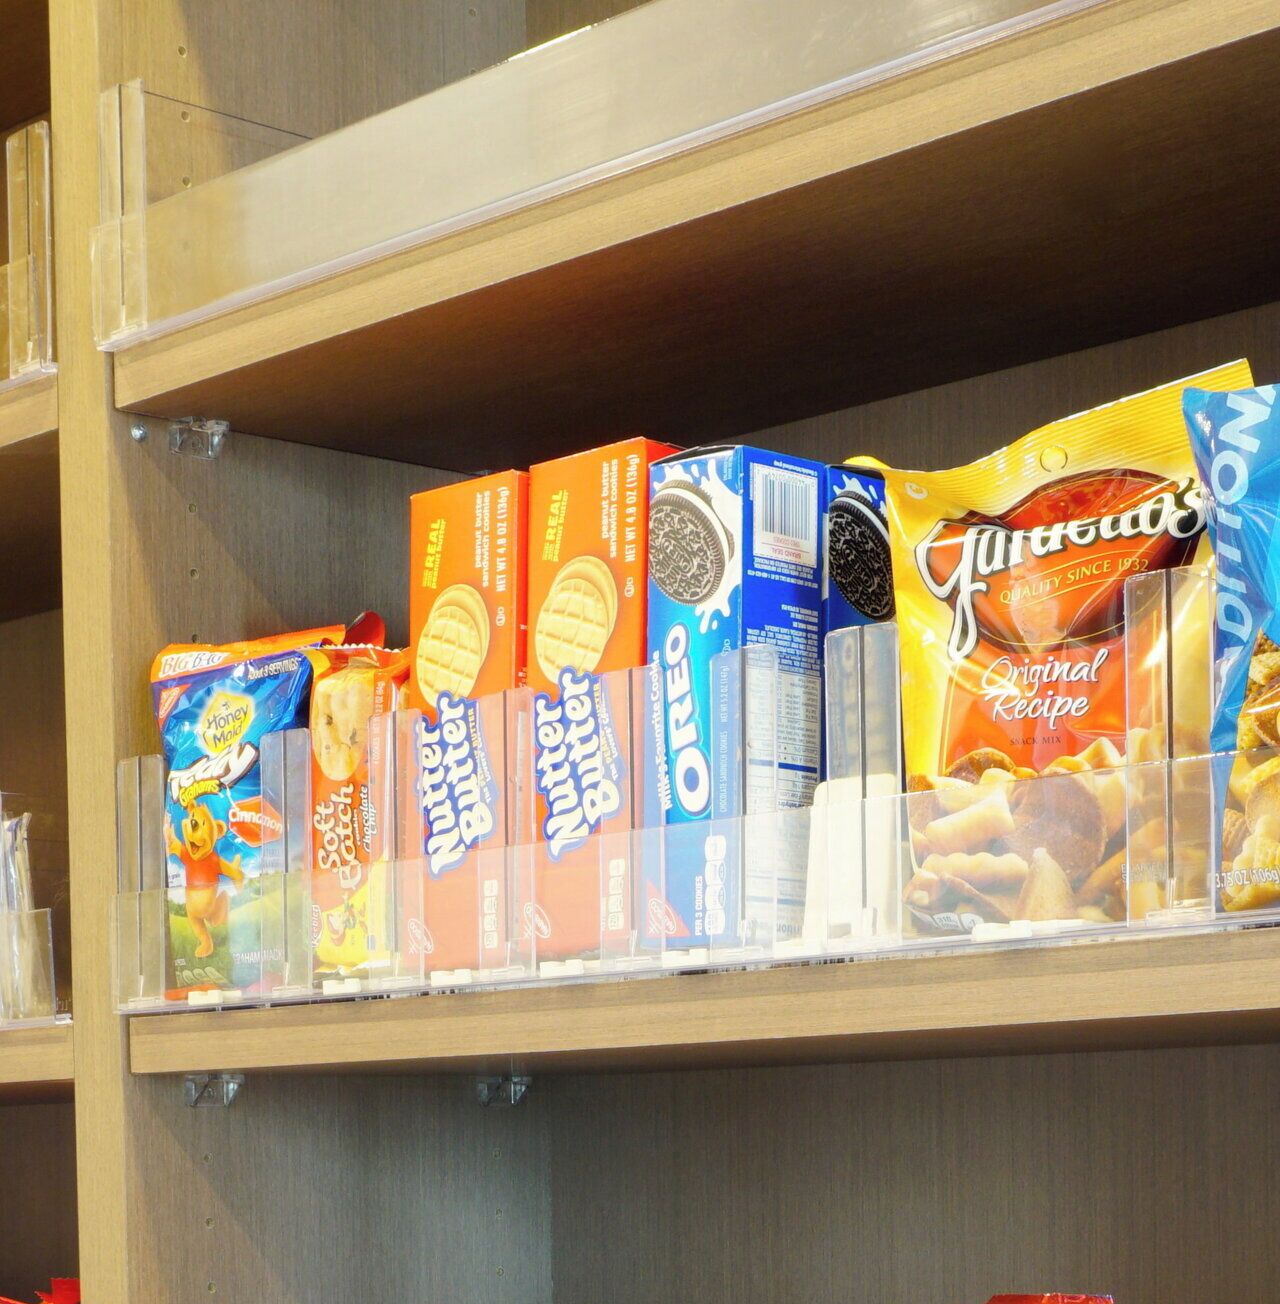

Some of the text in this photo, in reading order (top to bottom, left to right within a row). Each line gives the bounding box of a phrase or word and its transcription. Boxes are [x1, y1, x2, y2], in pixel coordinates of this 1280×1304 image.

[627, 453, 640, 486] (136g)
[497, 487, 510, 518] (136g)
[546, 489, 565, 543] REAL
[425, 519, 440, 567] REAL
[999, 557, 1149, 605] QUALITY SINCE 1932
[269, 657, 298, 675] SERVINGS
[980, 648, 1110, 696] Original
[207, 705, 249, 731] Honey
[649, 650, 666, 764] Favorite Cookie
[665, 623, 711, 815] OREO
[982, 689, 1090, 731] Recipe
[213, 722, 243, 748] Maid
[561, 670, 619, 824] Butter
[1009, 735, 1062, 746] SNACK MIX
[438, 695, 493, 844] Butter
[535, 697, 587, 855] Nutter
[359, 785, 373, 853] Chocolate
[416, 716, 469, 874] Nutter
[229, 808, 282, 832] Cinnamon
[314, 800, 342, 872] Soft
[335, 783, 362, 890] Batch
[694, 876, 702, 910] COOKIES
